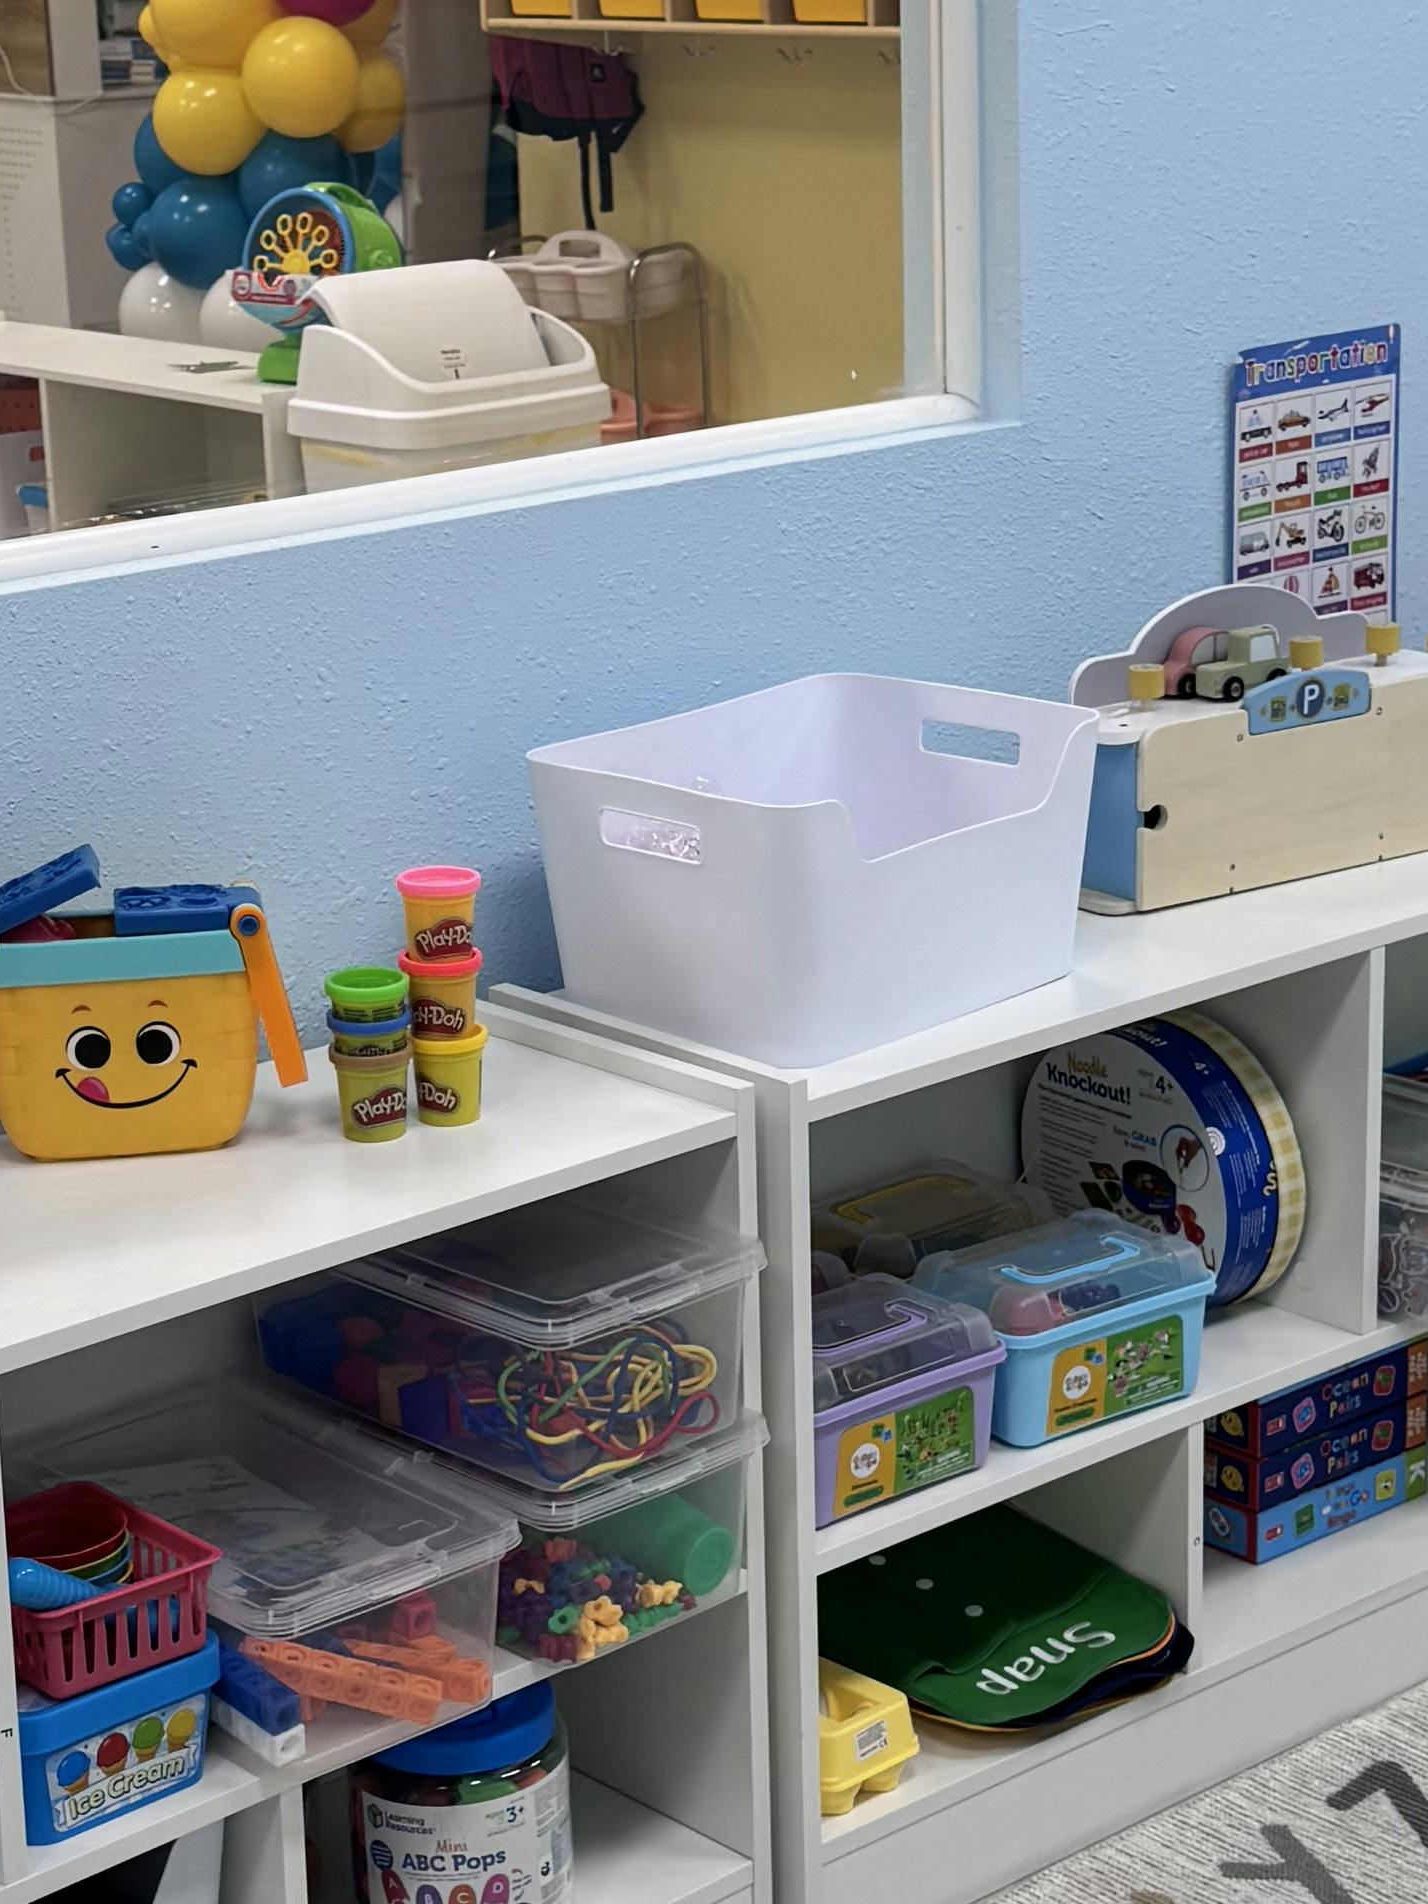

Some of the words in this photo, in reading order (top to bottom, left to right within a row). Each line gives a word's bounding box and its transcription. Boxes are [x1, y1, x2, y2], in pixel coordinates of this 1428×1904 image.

[1245, 339, 1388, 387] Transportation
[1303, 685, 1320, 712] P
[416, 924, 472, 953] Play-Do
[412, 1006, 466, 1031] ay-Doh
[1067, 1051, 1109, 1079] Noodle
[1046, 1062, 1132, 1106] Knockout!
[1155, 1076, 1174, 1095] 4+
[1322, 1372, 1369, 1401] Ocean
[1329, 1395, 1361, 1418] Pairs
[1320, 1428, 1368, 1456] Ocean
[976, 1621, 1115, 1695] Snap
[64, 1788, 106, 1827] Ice
[108, 1755, 184, 1799] Cream
[385, 1811, 425, 1826] Learning
[385, 1822, 432, 1835] Resources
[436, 1839, 468, 1853] Mini
[402, 1853, 447, 1872] ABC
[453, 1850, 506, 1872] Pops
[457, 1892, 470, 1904] C
[492, 1882, 503, 1893] D
